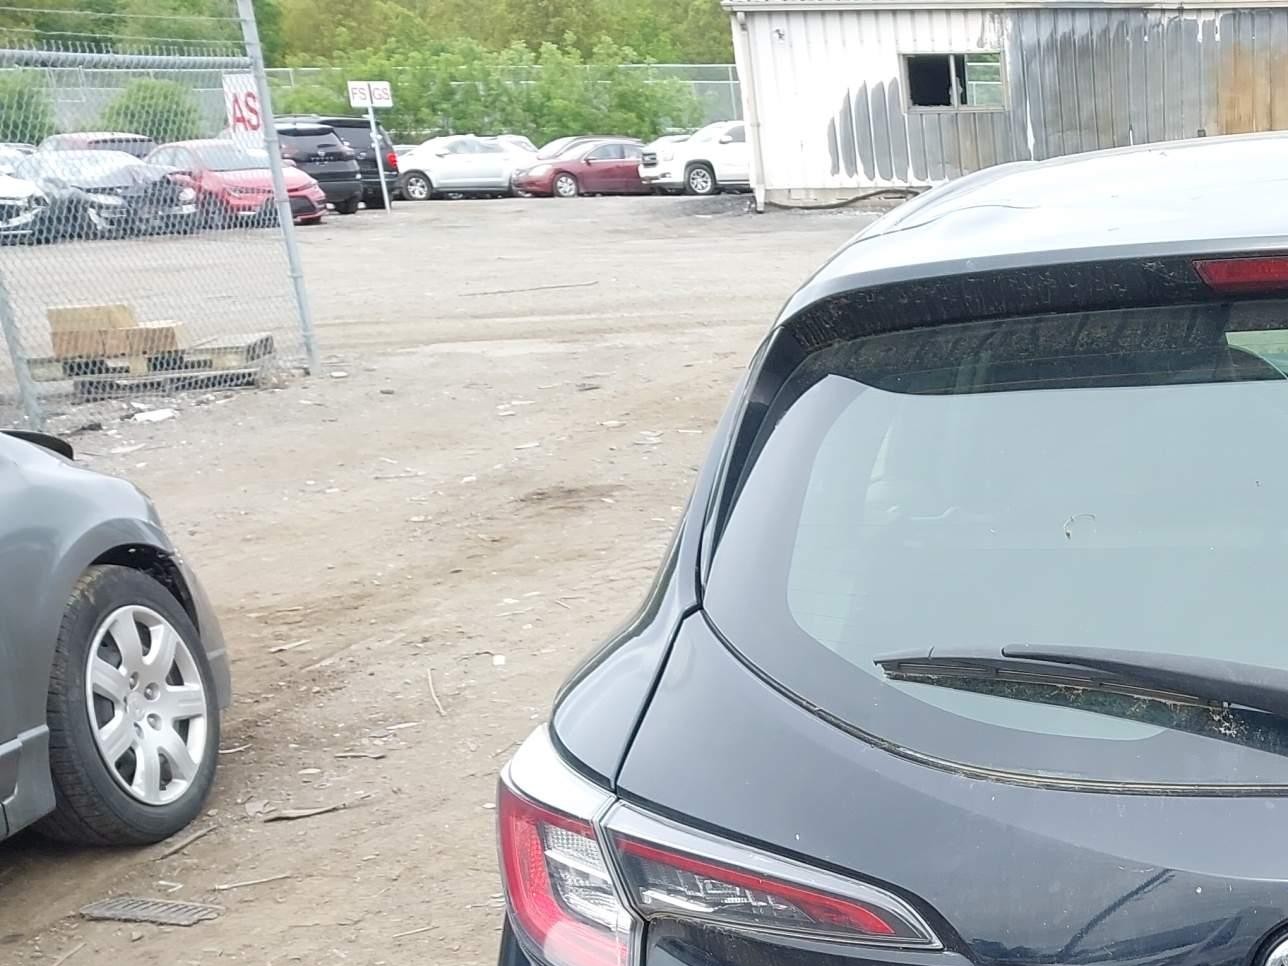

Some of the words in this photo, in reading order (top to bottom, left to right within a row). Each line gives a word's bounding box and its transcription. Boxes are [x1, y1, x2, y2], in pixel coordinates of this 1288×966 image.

[350, 87, 367, 101] FS
[372, 87, 391, 101] GS
[231, 90, 261, 132] AS
